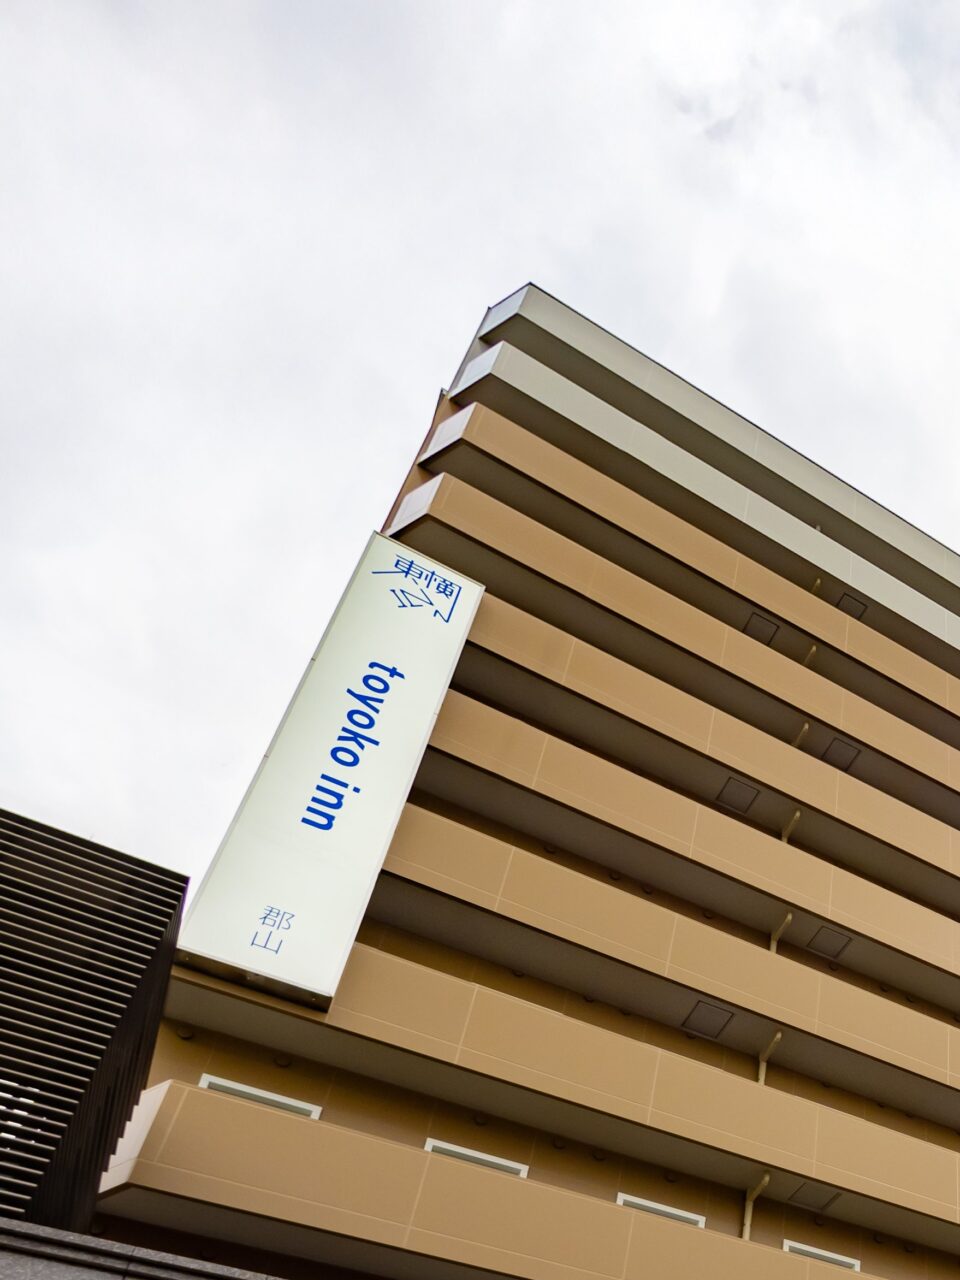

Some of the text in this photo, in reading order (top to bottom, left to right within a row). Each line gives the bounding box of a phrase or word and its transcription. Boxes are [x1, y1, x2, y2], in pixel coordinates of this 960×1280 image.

[300, 660, 405, 831] toyoko inn
[250, 905, 295, 955] 郡山
